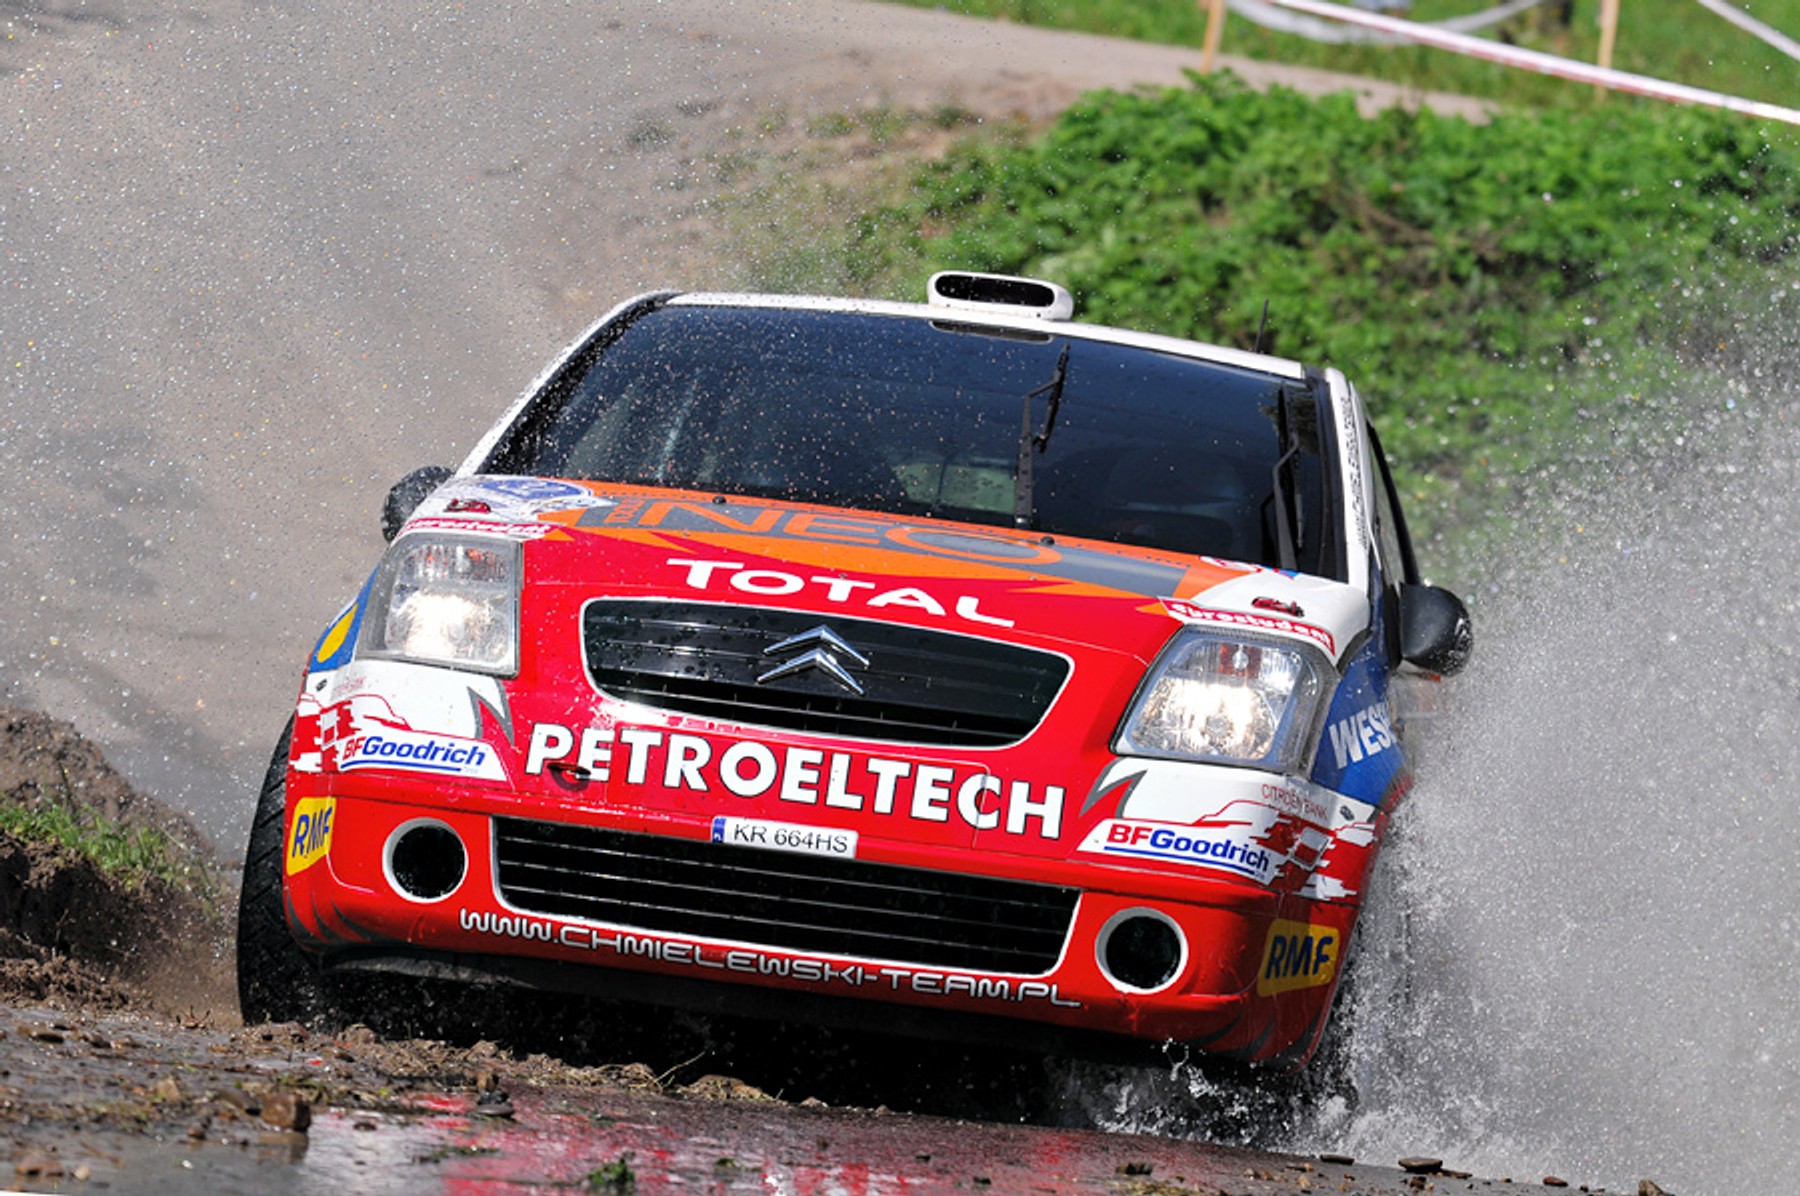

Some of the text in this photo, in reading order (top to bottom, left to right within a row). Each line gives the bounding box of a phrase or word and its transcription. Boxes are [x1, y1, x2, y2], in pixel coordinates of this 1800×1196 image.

[666, 558, 1015, 628] TOTAL
[342, 736, 486, 766] BFGoodrich
[524, 722, 1065, 840] PETROELTECH
[292, 806, 333, 858] RMF
[734, 824, 768, 844] KR
[774, 828, 848, 854] 664HS
[1106, 823, 1269, 872] BFGoodrich
[459, 908, 1082, 1009] WWW.CHMIELEWSKI-TEAM.PL
[1265, 935, 1333, 980] RMF
